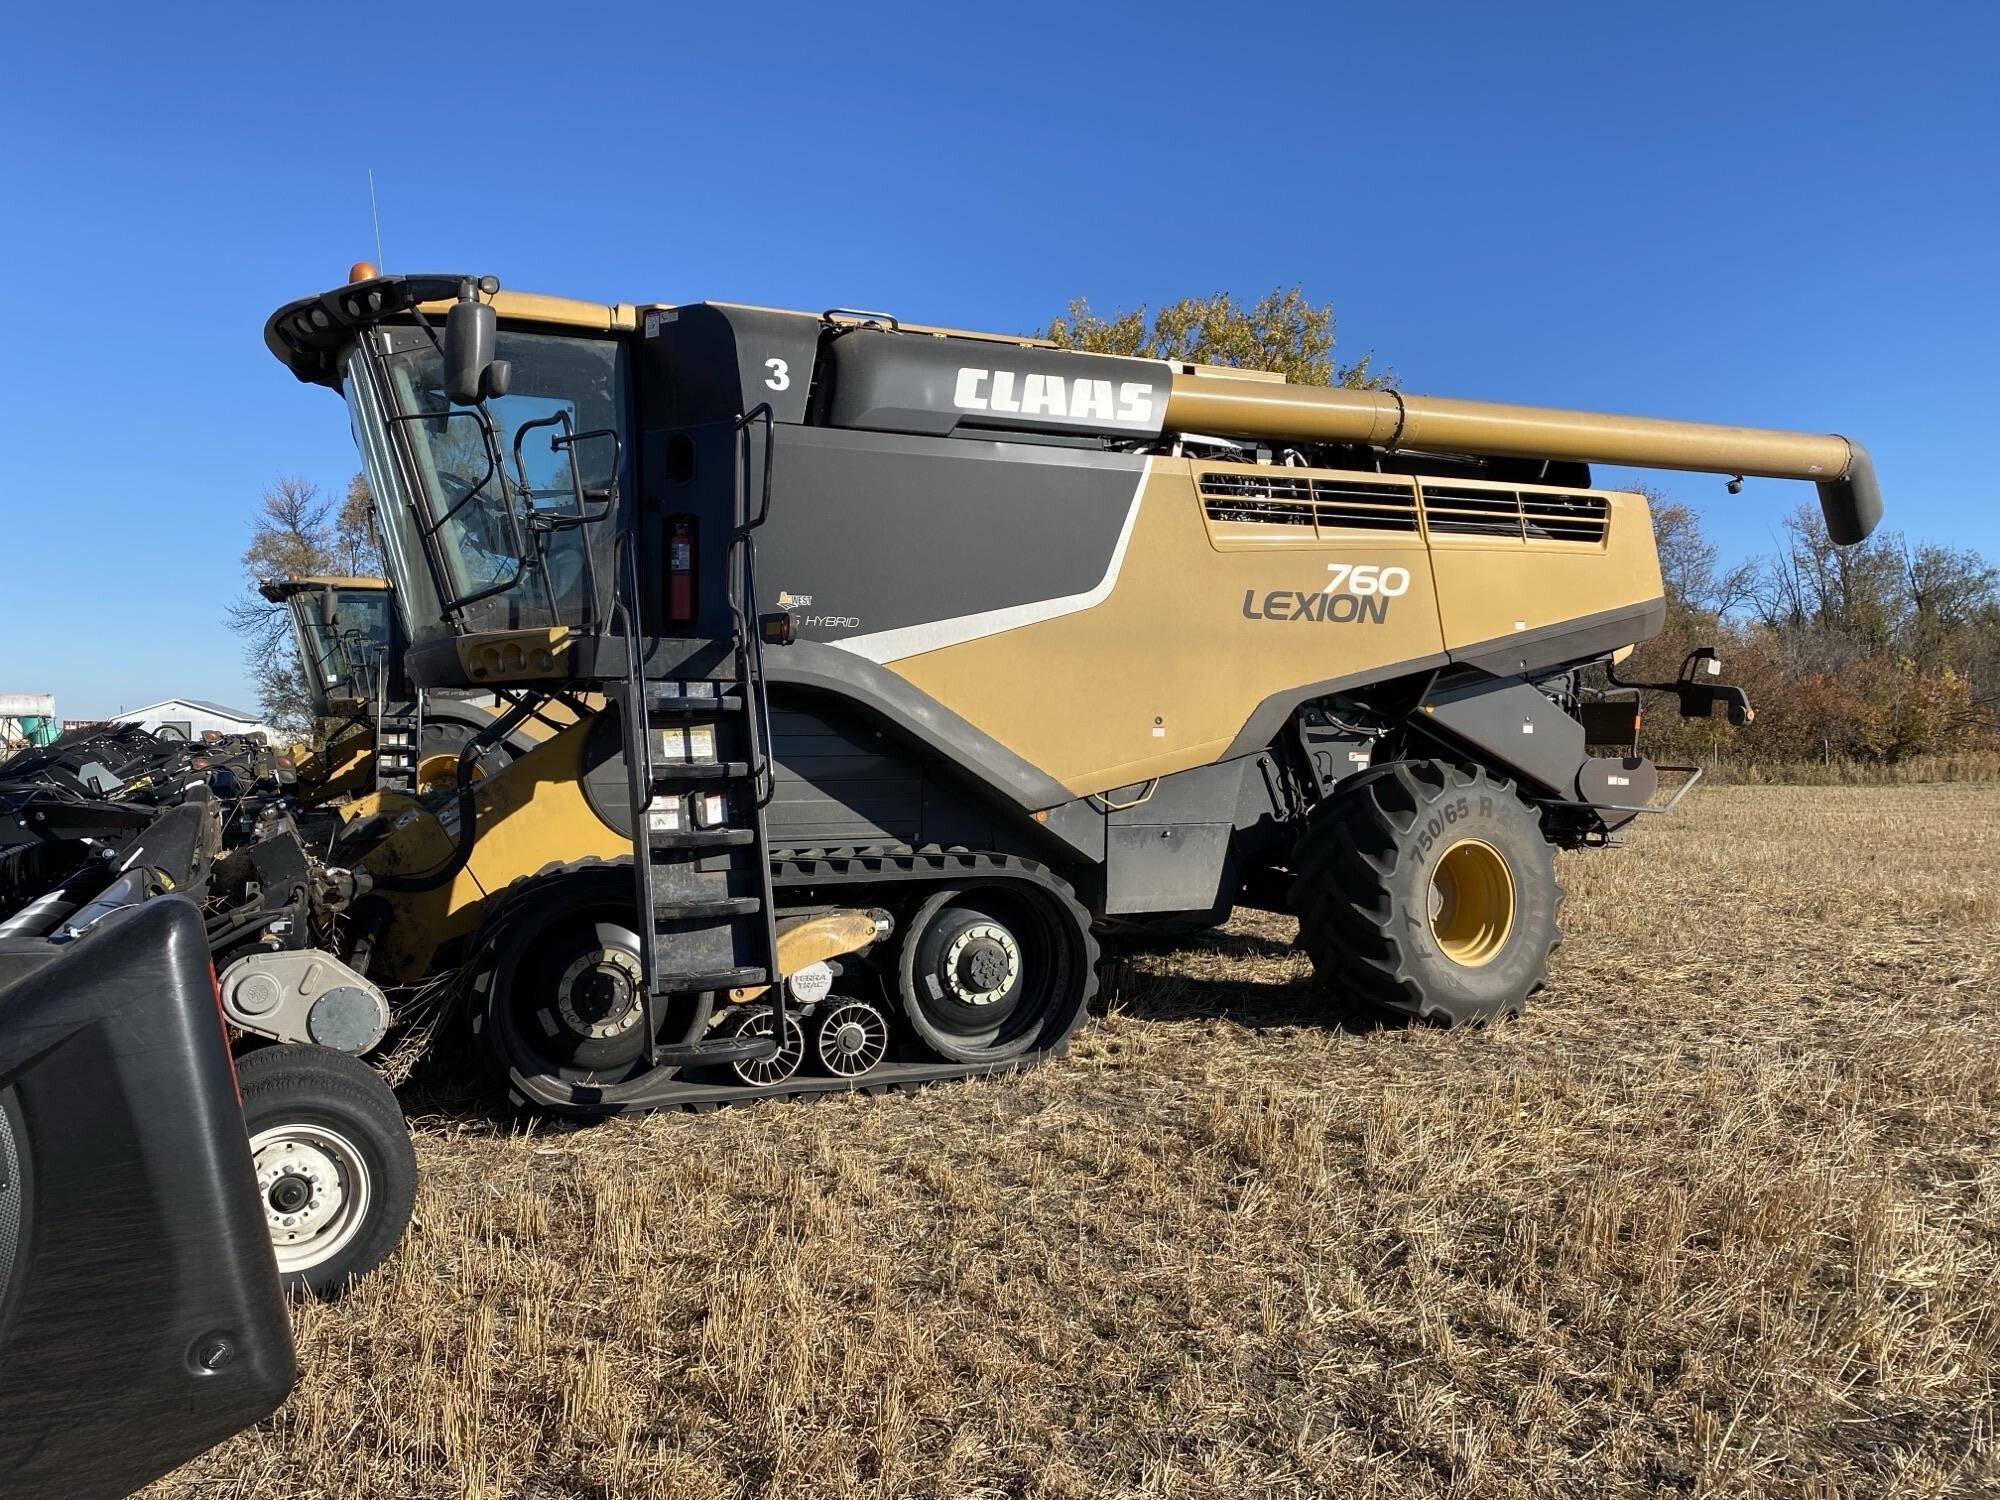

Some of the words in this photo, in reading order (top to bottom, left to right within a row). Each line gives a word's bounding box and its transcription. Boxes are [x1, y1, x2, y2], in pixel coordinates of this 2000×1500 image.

[764, 358, 790, 391] 3
[954, 367, 1153, 422] CLAAS
[1321, 563, 1411, 597] 760
[805, 615, 860, 628] HYBRID
[1242, 589, 1391, 625] LEXION
[1409, 796, 1471, 866] 750/65
[1479, 796, 1494, 819] R
